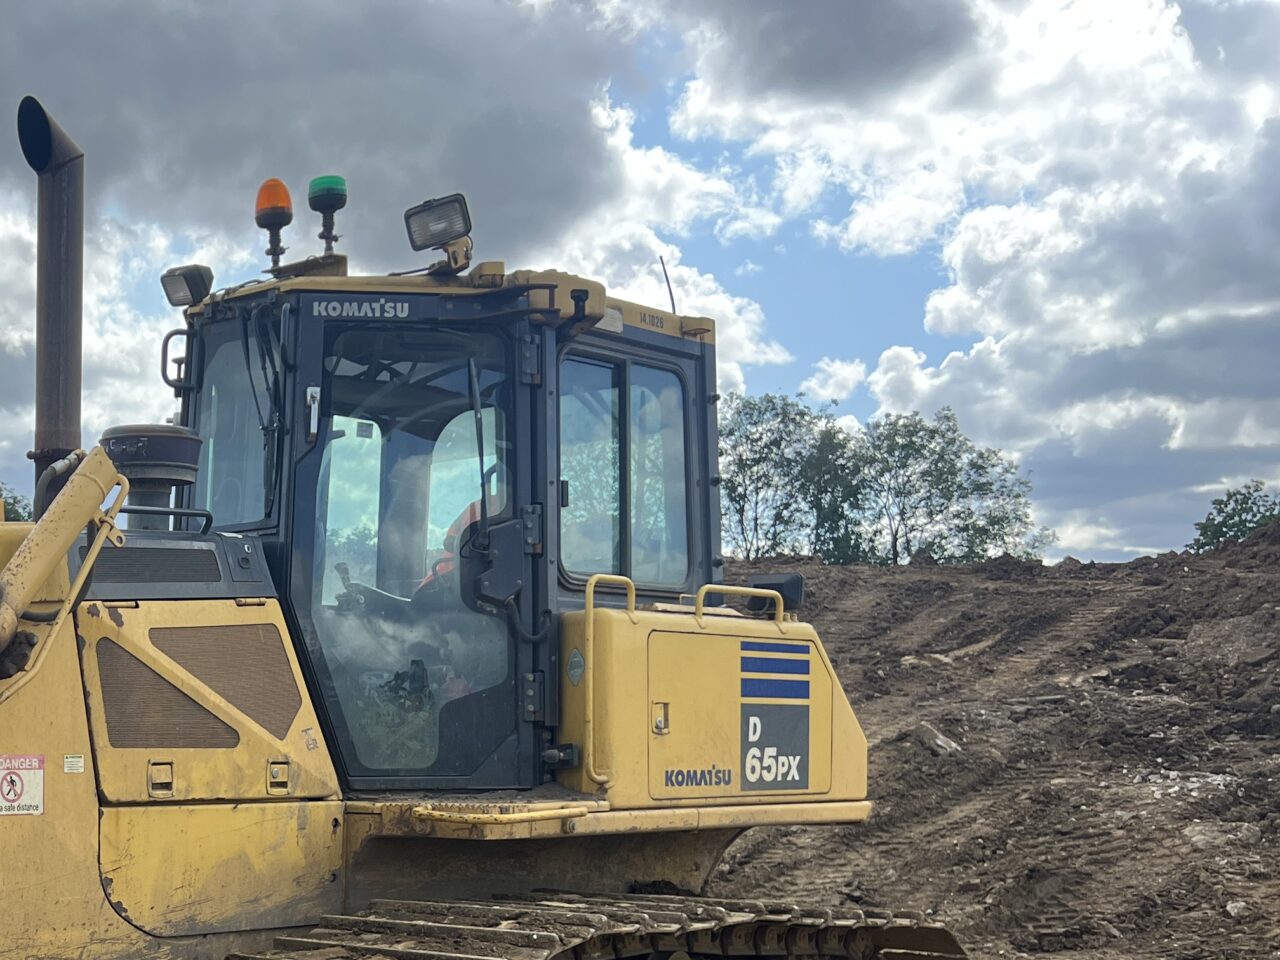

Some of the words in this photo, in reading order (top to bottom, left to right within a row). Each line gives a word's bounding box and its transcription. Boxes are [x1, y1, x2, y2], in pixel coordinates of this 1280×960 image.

[313, 298, 409, 318] KOMATSU
[748, 716, 761, 742] D
[665, 764, 732, 787] KOMATSU
[745, 747, 801, 782] 65PX
[4, 803, 16, 812] safe
[16, 803, 39, 812] distance
